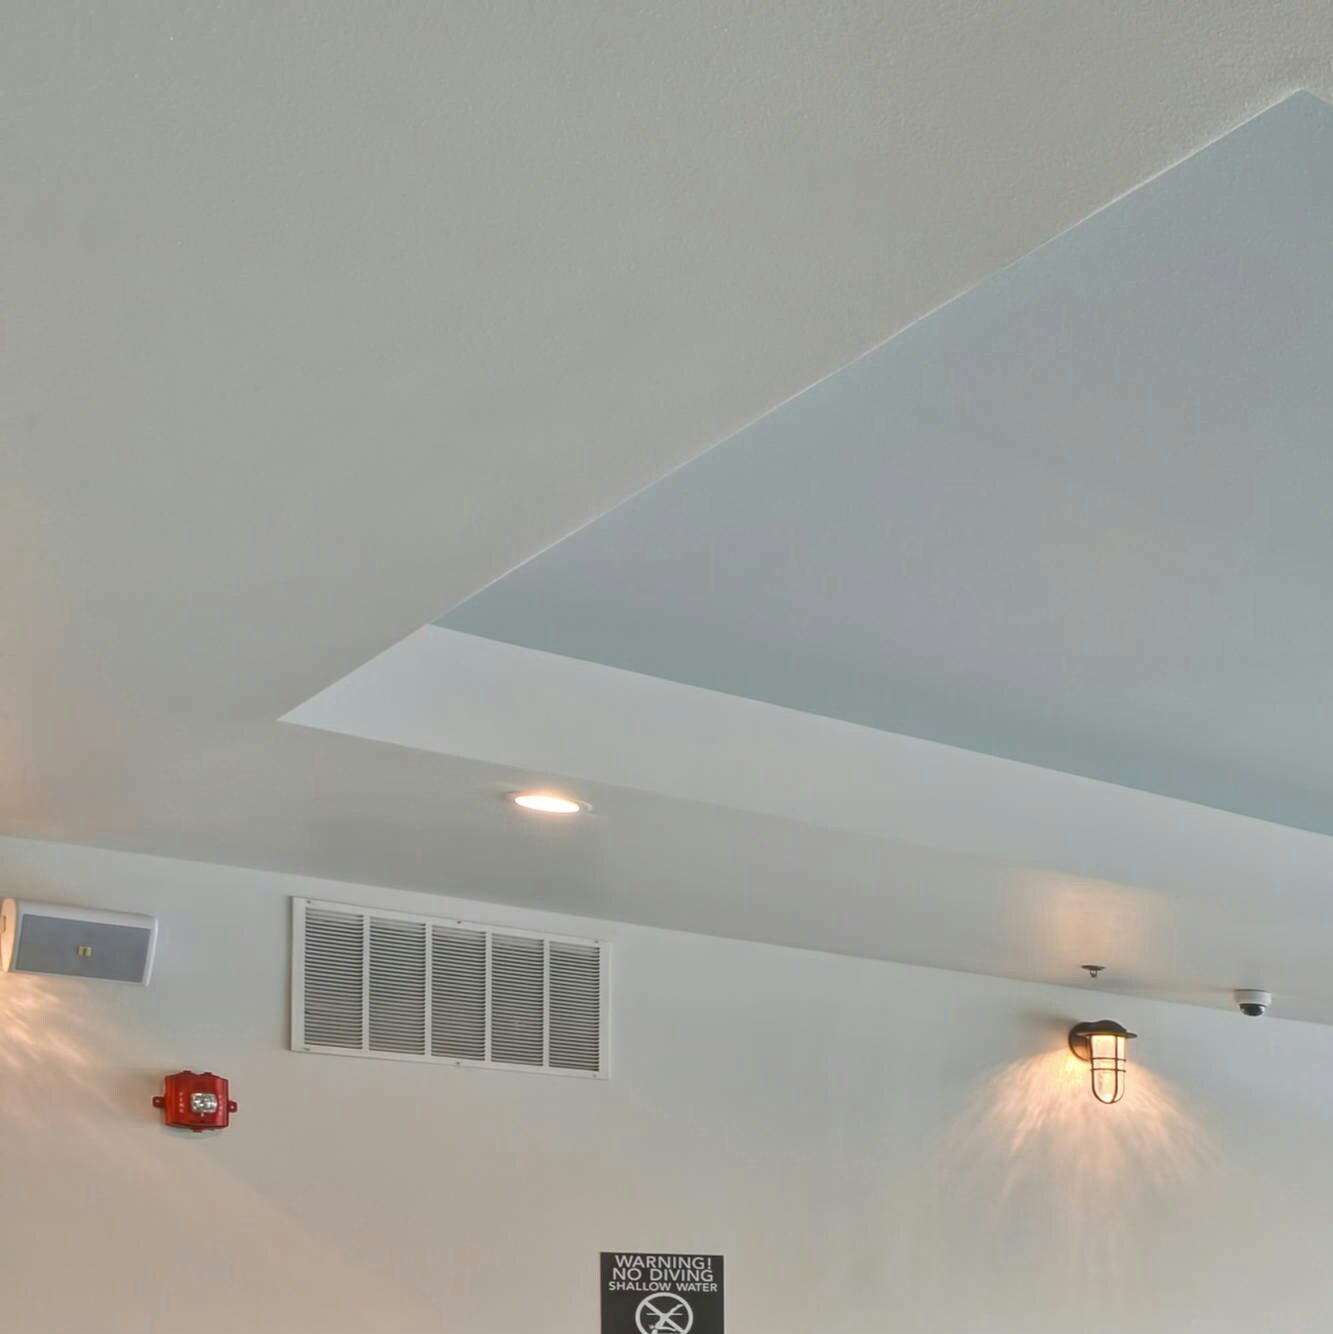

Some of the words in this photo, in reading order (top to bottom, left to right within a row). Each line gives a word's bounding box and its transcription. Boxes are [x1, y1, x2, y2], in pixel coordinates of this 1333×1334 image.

[615, 1255, 712, 1270] WARNING!
[612, 1267, 642, 1281] NO
[650, 1268, 714, 1282] DIVING
[608, 1281, 671, 1291] SHALLOW
[676, 1282, 718, 1292] WATER
